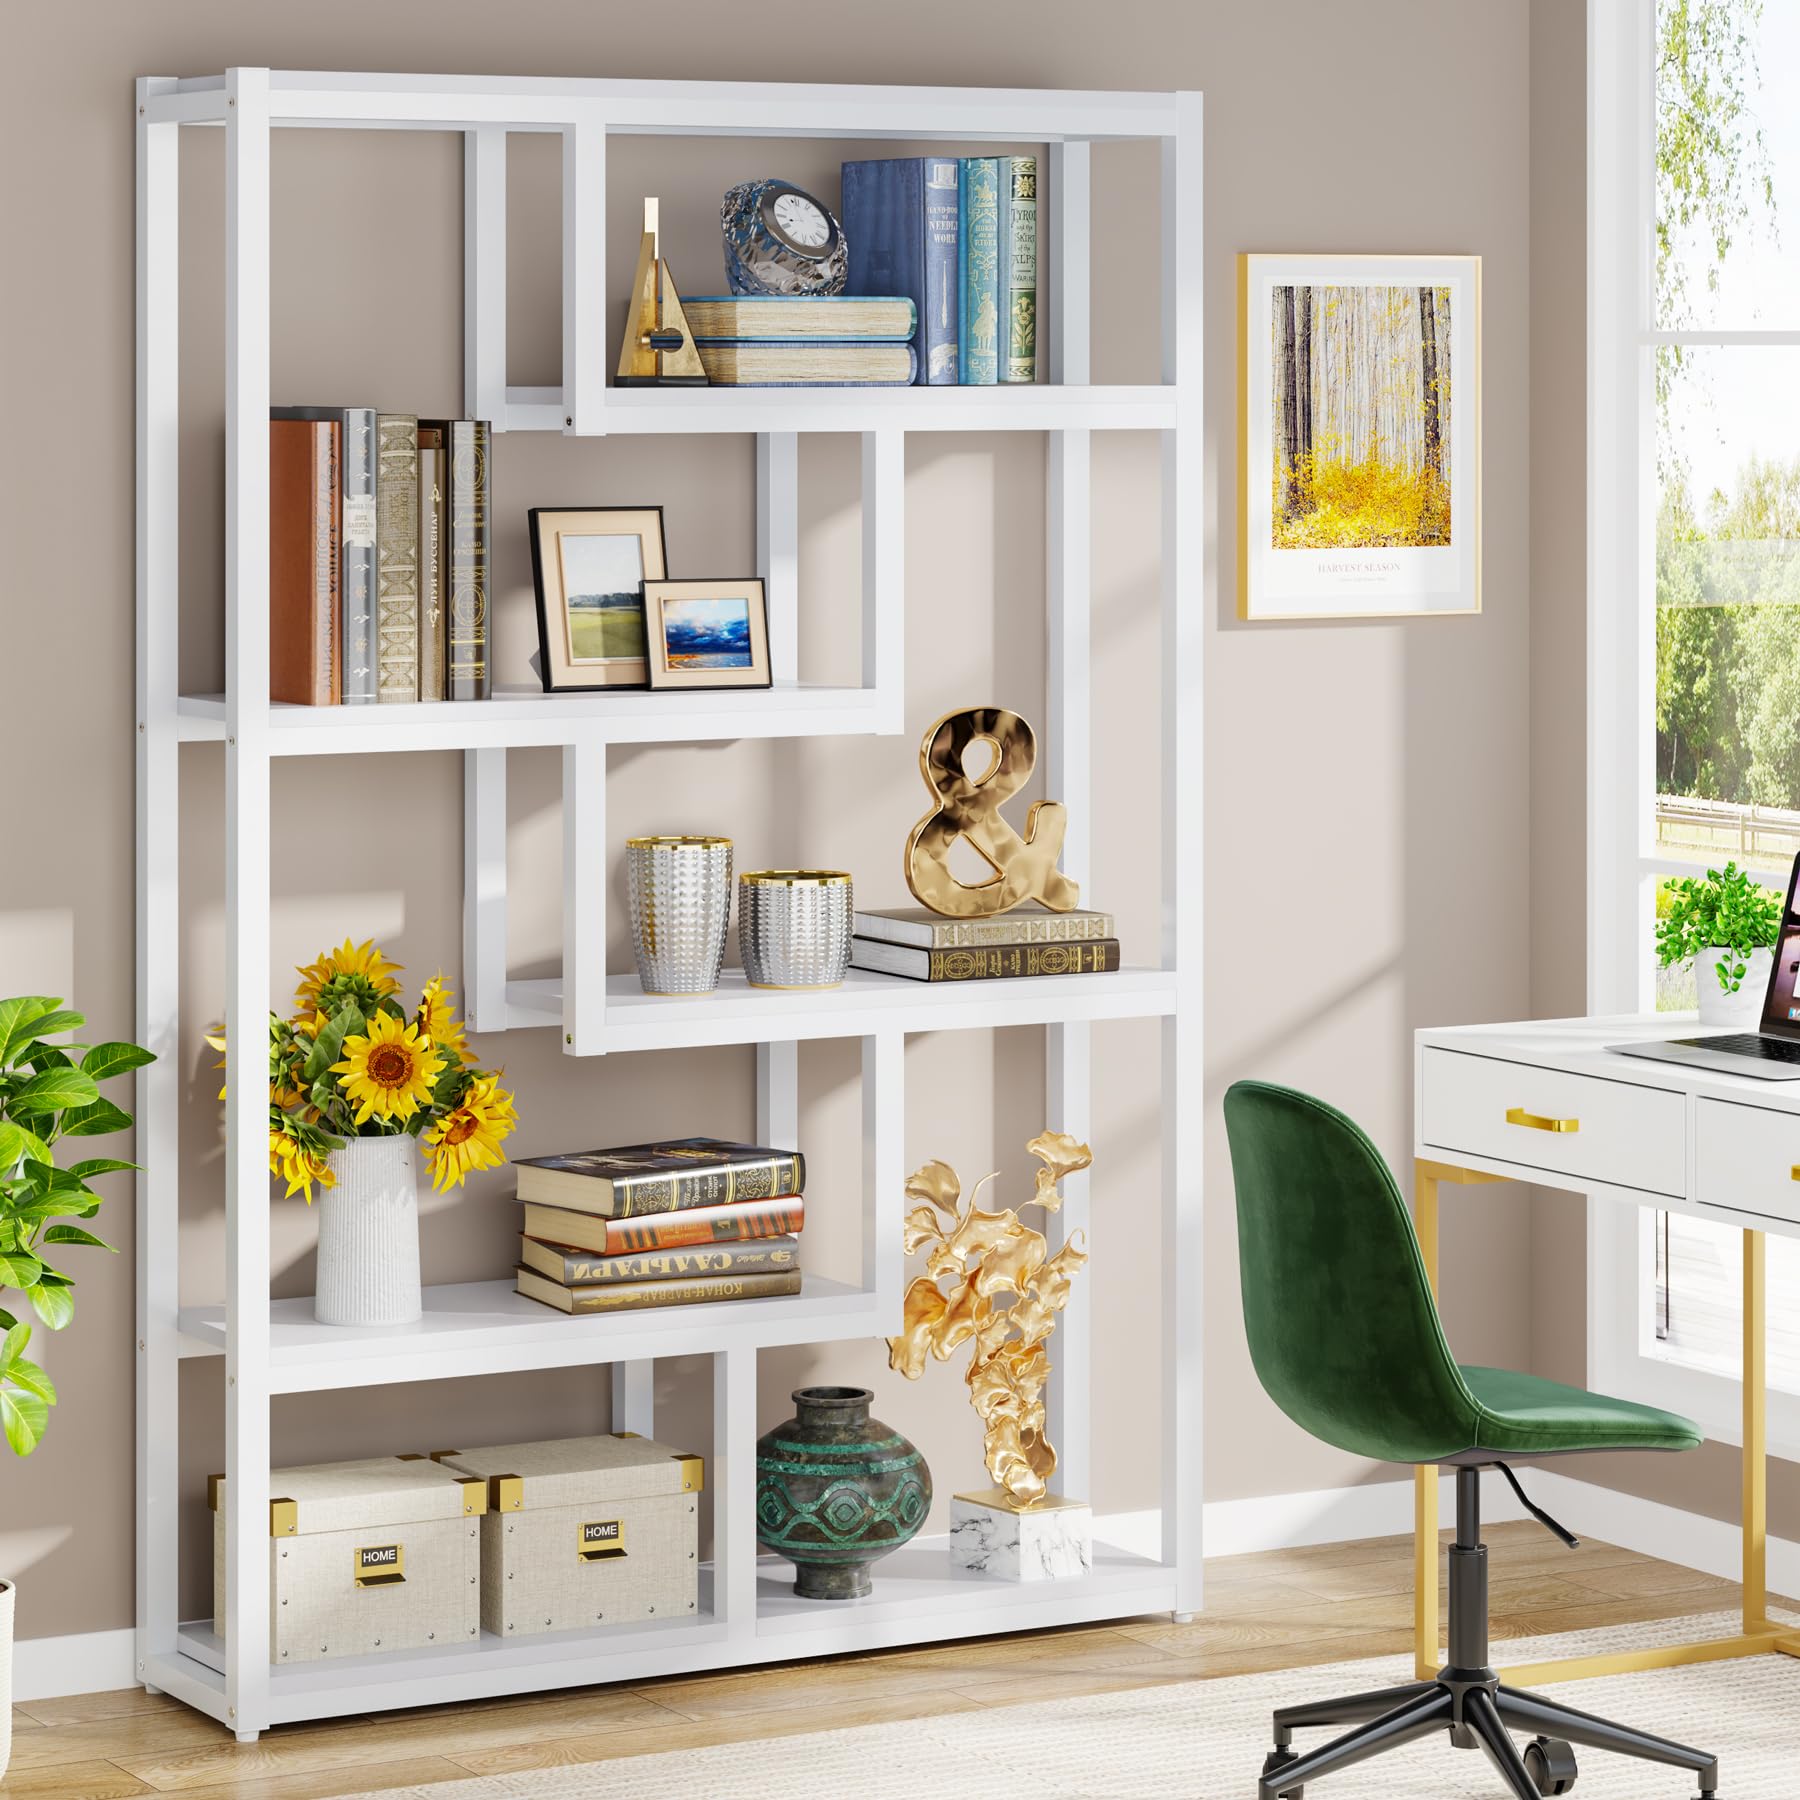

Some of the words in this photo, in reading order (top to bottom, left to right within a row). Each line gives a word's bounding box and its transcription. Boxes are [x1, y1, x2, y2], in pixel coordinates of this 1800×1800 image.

[934, 233, 956, 244] WORK
[430, 511, 438, 573] БУССЕНАР
[1318, 562, 1362, 573] HARVEST
[1364, 562, 1401, 572] SEASON
[430, 579, 438, 605] ЛУИ
[572, 1252, 732, 1280] САЛЬГАРИ
[642, 1282, 743, 1302] КОНАН-ВАРВАР
[586, 1524, 618, 1538] HOME
[363, 1549, 396, 1563] HOME
